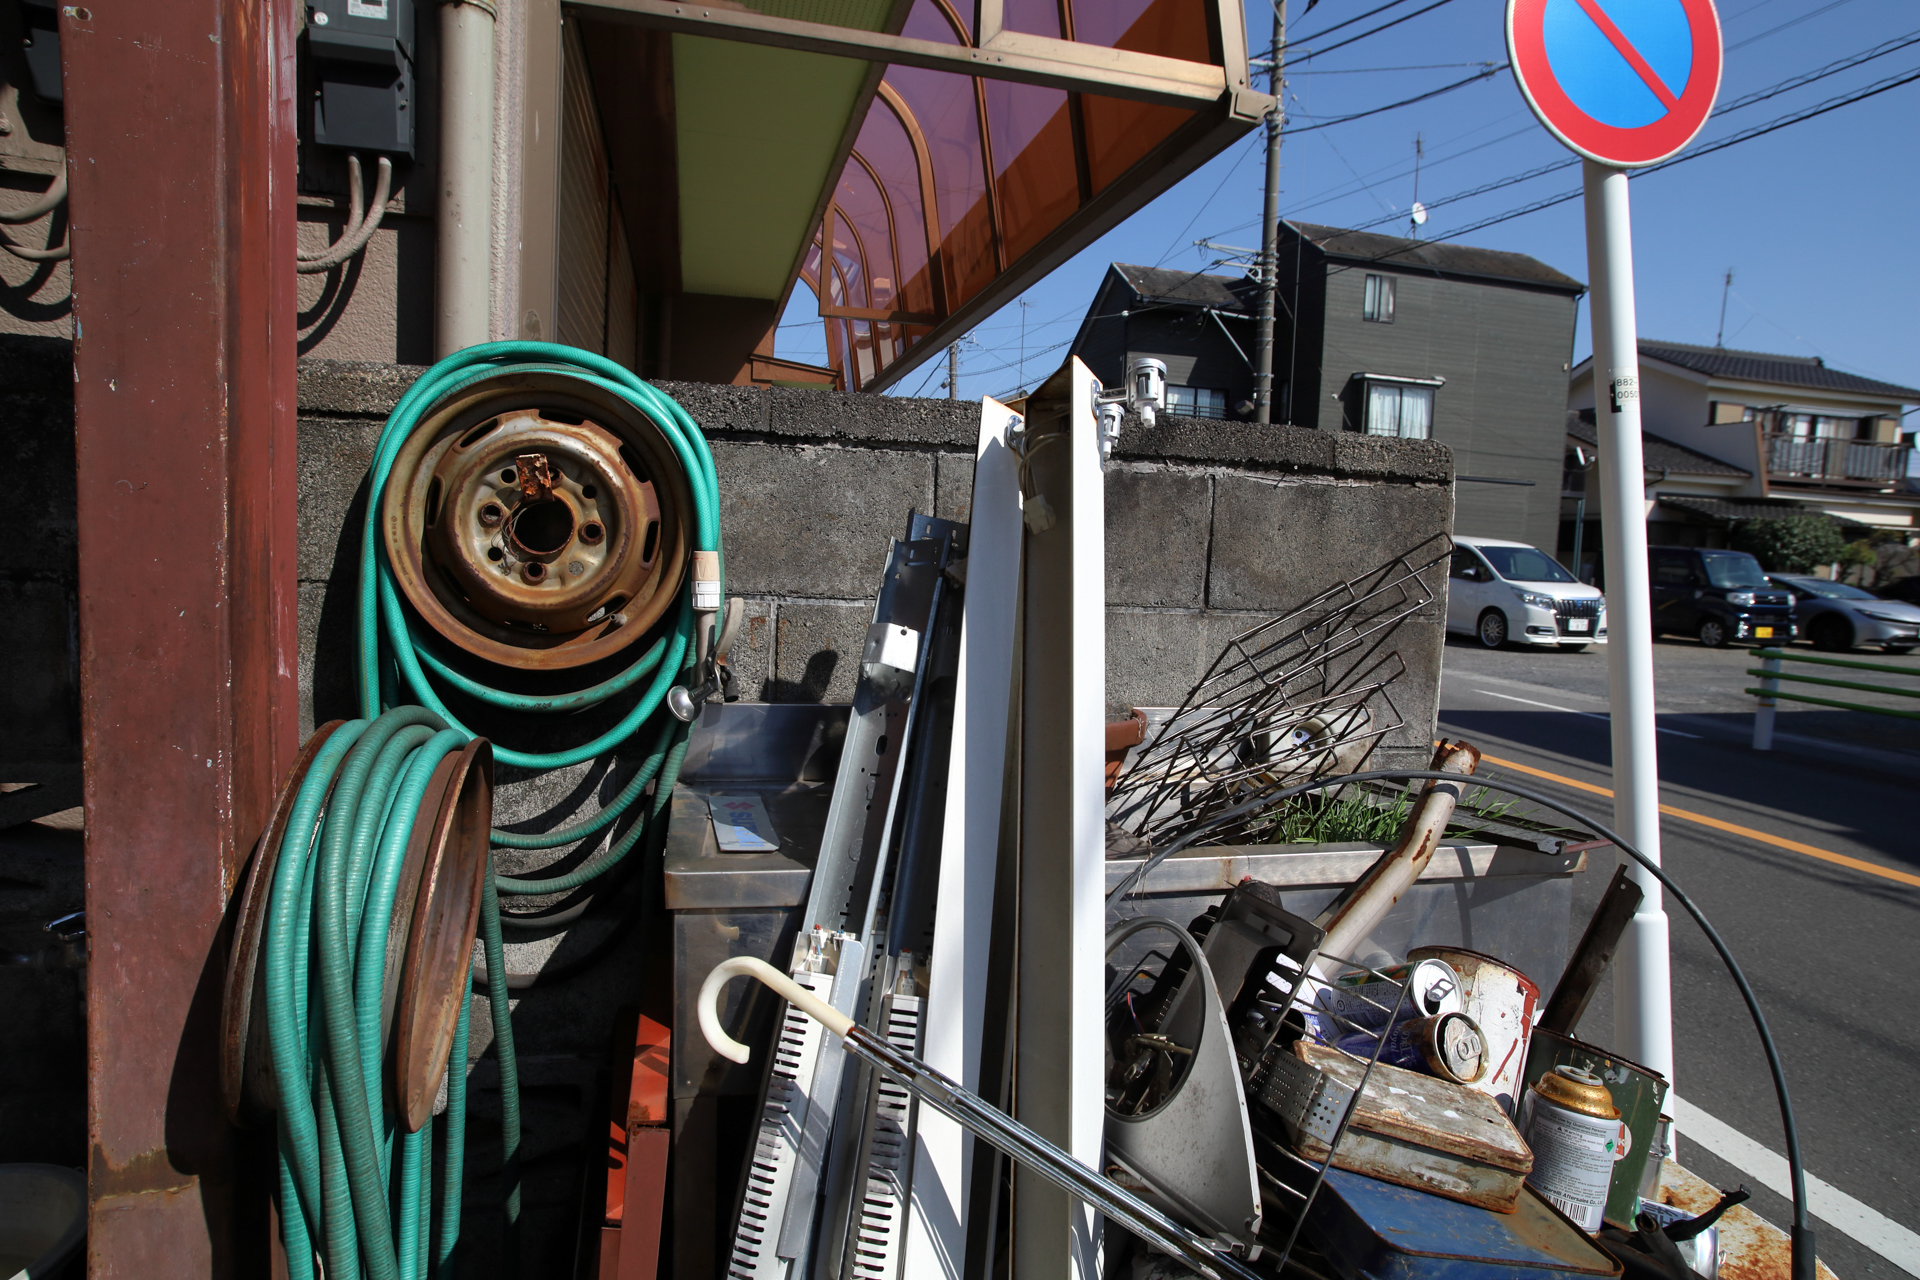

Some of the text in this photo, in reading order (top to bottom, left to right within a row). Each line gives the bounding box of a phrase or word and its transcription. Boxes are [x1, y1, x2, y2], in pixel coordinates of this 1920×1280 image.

[729, 812, 764, 846] SUZUKI
[1543, 1185, 1561, 1196] Marelli
[1562, 1193, 1589, 1204] Aftersales
